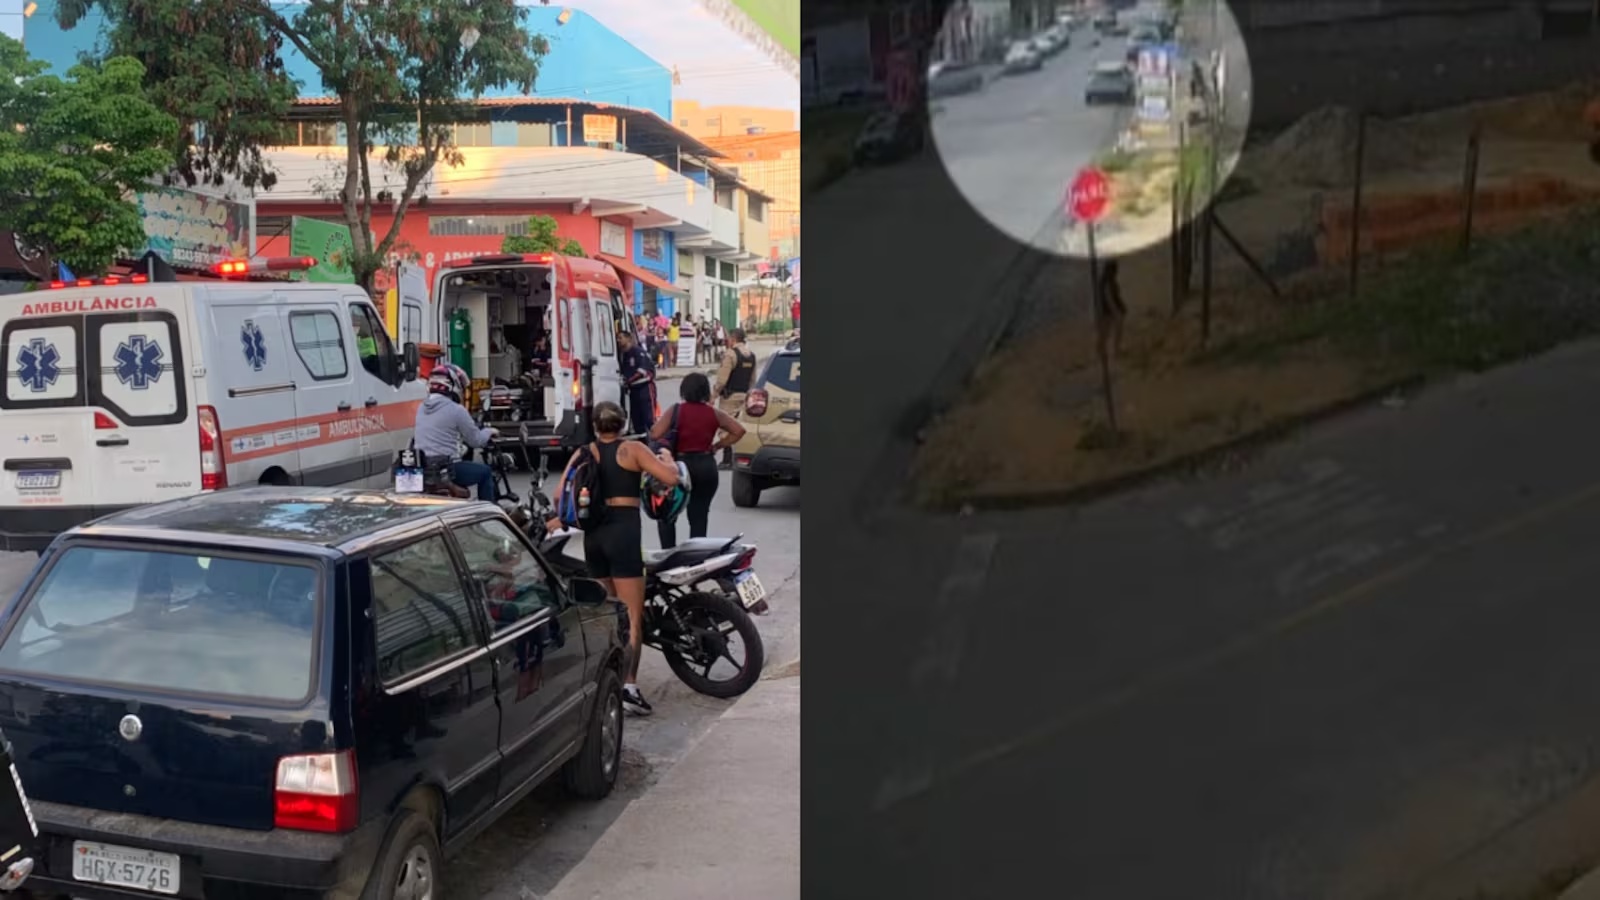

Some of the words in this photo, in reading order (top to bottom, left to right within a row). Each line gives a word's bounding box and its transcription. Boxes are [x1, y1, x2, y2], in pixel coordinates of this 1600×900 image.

[425, 252, 435, 267] &
[22, 296, 157, 316] AMBULÂNCIA
[328, 413, 385, 438] AMBULÂNCIA
